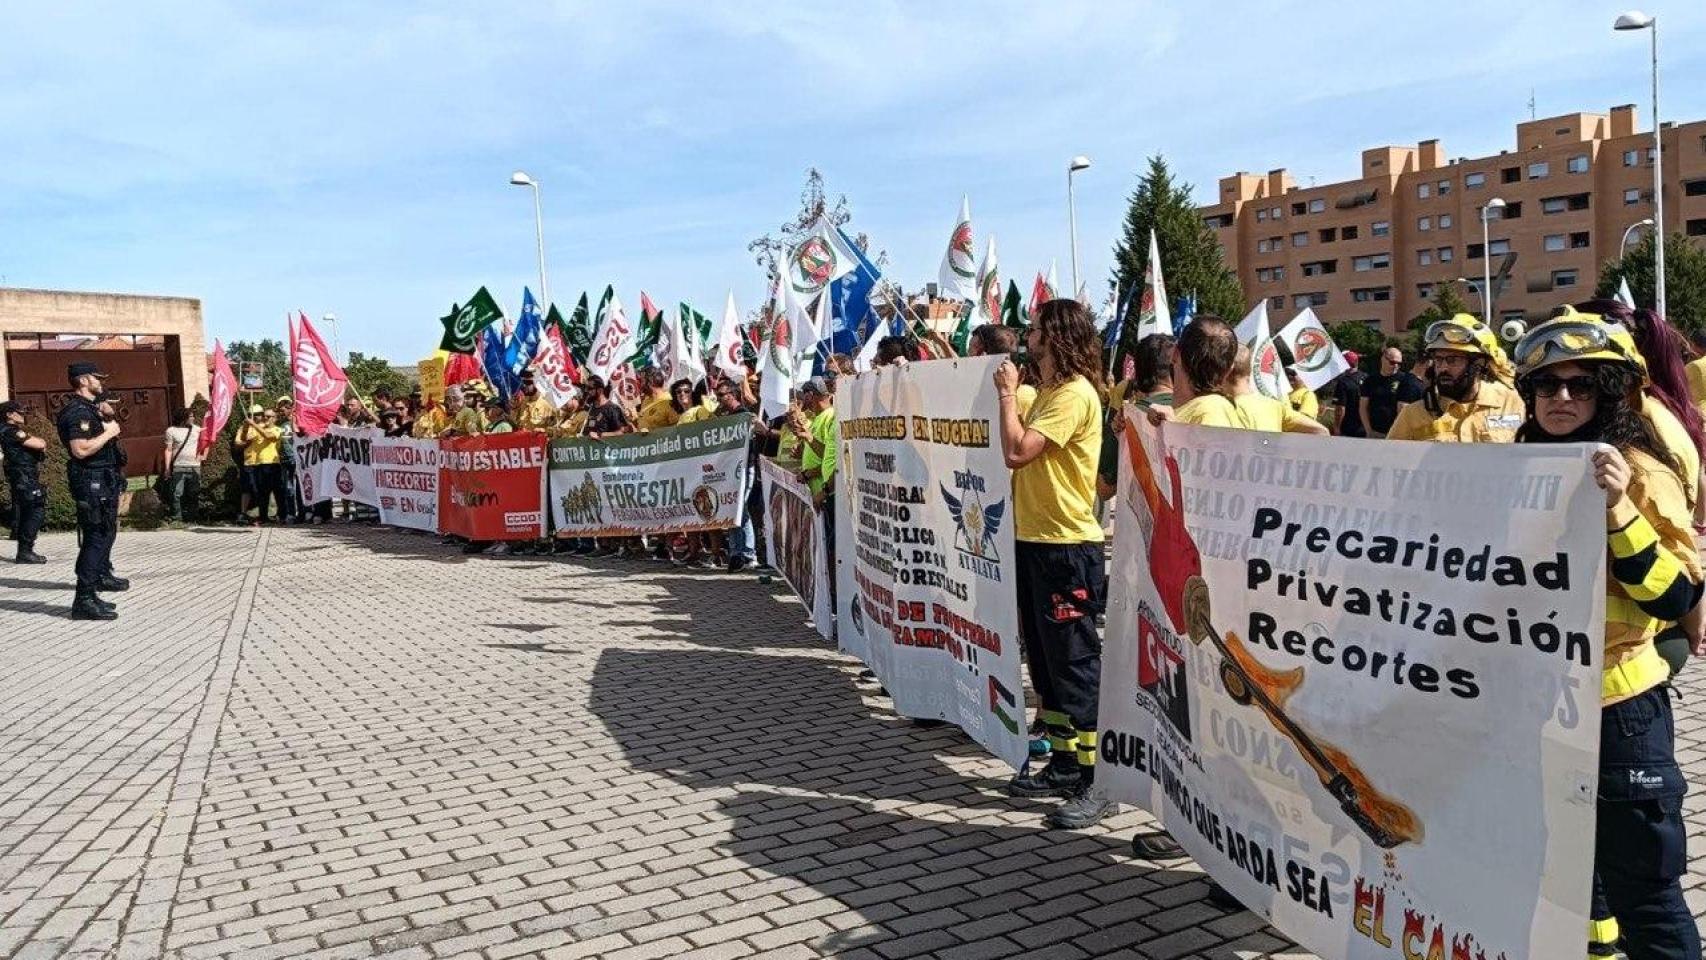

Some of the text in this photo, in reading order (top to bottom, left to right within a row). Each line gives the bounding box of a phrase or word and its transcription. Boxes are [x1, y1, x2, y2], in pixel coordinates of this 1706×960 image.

[913, 416, 930, 439] EN
[474, 445, 543, 471] ESTABLE
[552, 446, 587, 463] CONTRA
[589, 445, 600, 461] la
[604, 435, 682, 461] temporalidad
[684, 434, 700, 450] en
[384, 469, 437, 492] RECORTES
[603, 477, 691, 509] FORESTAL
[1251, 507, 1571, 591] Precariedad
[958, 553, 1001, 583] ATALAYA
[1247, 558, 1592, 667] Privatización
[1248, 611, 1481, 700] Recortes
[1101, 729, 1147, 773] QUE
[1193, 796, 1225, 854] QUE
[1225, 825, 1282, 893] ARDA
[1285, 859, 1334, 919] SEA
[1353, 876, 1393, 949] EL
